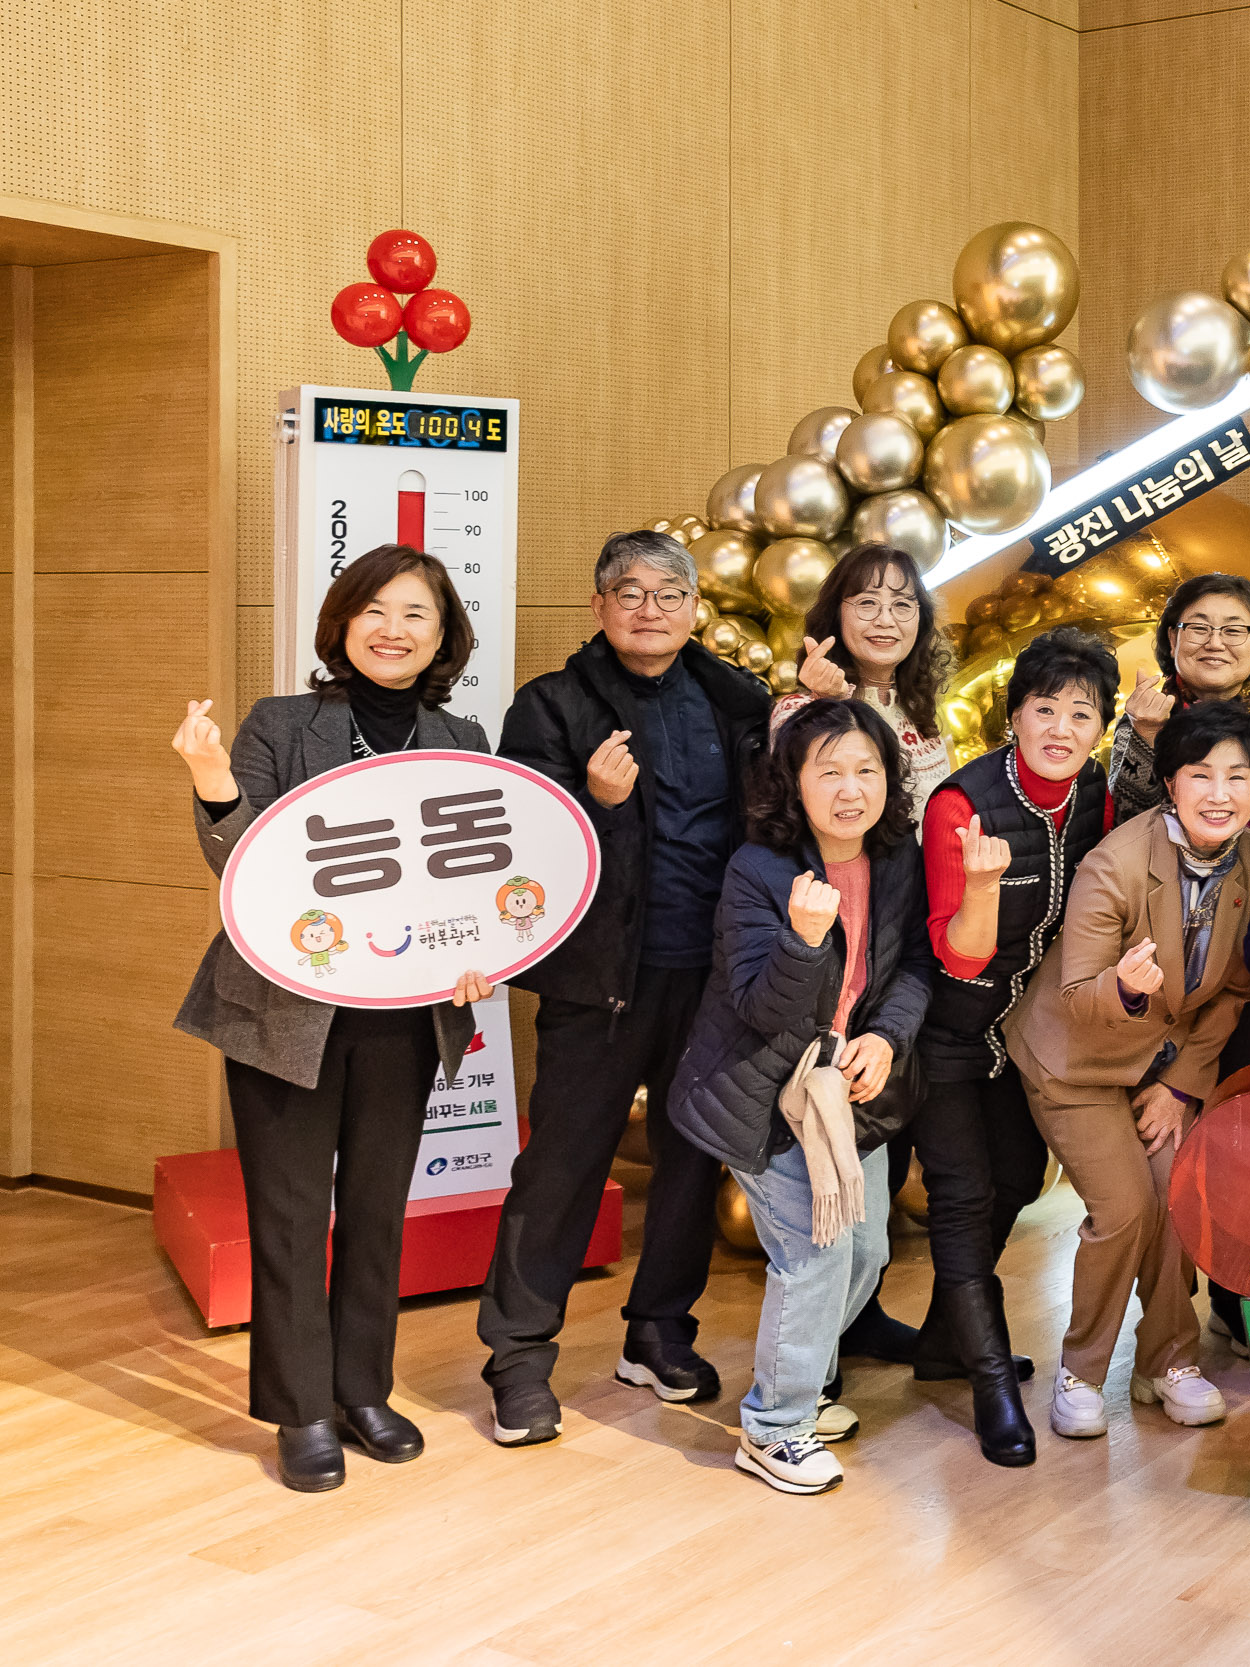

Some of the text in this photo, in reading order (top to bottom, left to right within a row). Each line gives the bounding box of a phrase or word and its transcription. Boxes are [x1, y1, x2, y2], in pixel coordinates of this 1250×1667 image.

[323, 406, 502, 441] 사랑의 온도 100.4 도
[464, 490, 489, 501] 100
[1043, 505, 1119, 564] 광진
[1111, 449, 1216, 523] 나눔의
[464, 525, 482, 536] 90
[464, 563, 481, 574] 80
[463, 601, 480, 612] 70
[462, 676, 479, 687] 50
[305, 788, 513, 898] 능동
[419, 925, 480, 950] 행복광진
[432, 1072, 495, 1092] 하는 기부
[426, 1099, 498, 1119] 바꾸는 서울
[451, 1152, 492, 1167] 광진구
